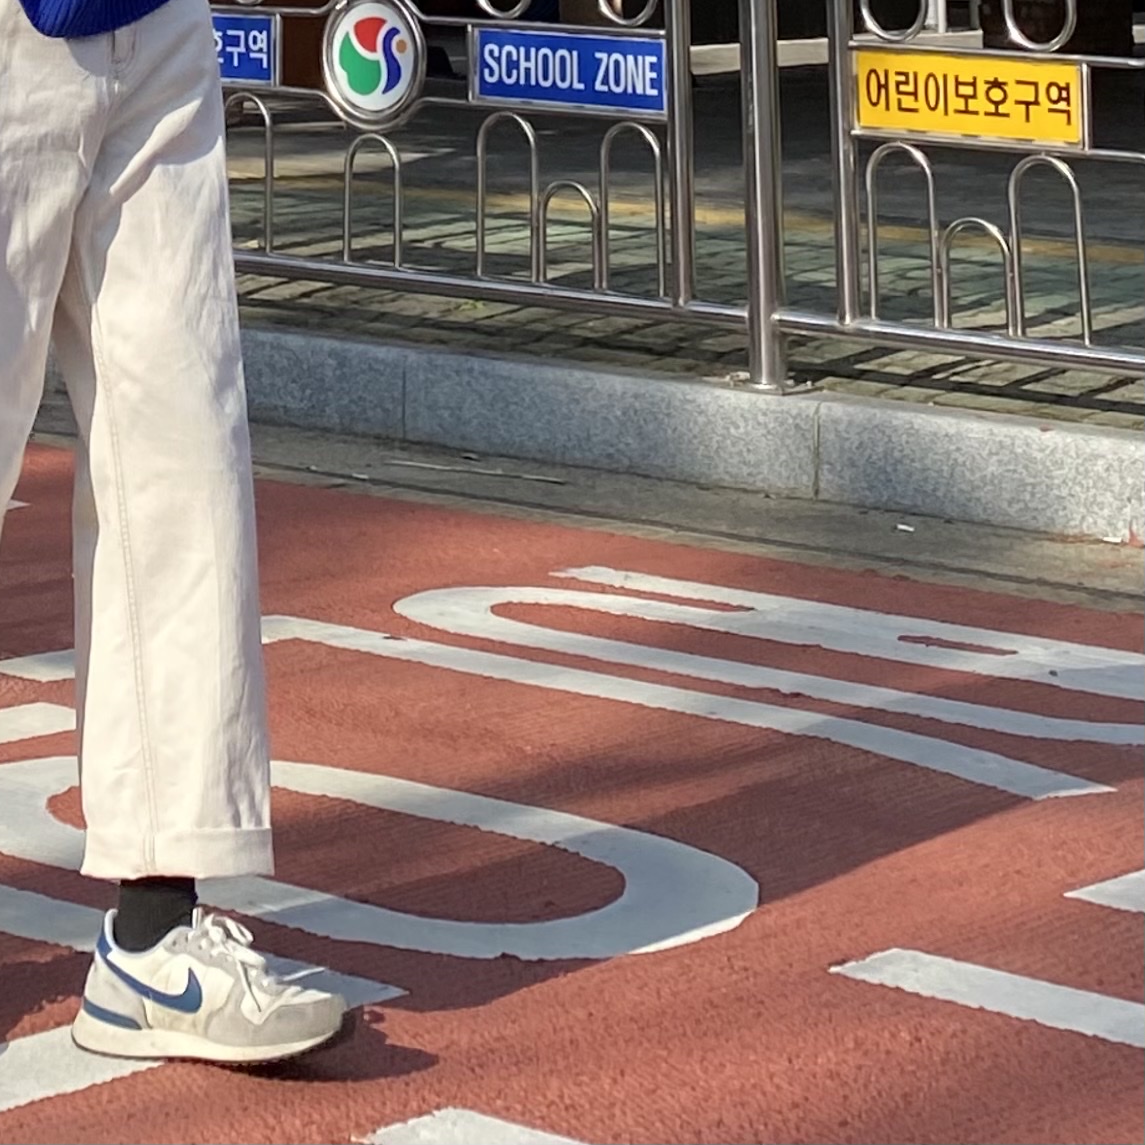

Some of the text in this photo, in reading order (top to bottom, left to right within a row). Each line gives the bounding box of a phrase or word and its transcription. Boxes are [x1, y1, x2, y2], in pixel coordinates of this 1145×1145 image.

[483, 43, 659, 96] SCHOOL ZONE
[865, 68, 1071, 125] 어린이보호구역
